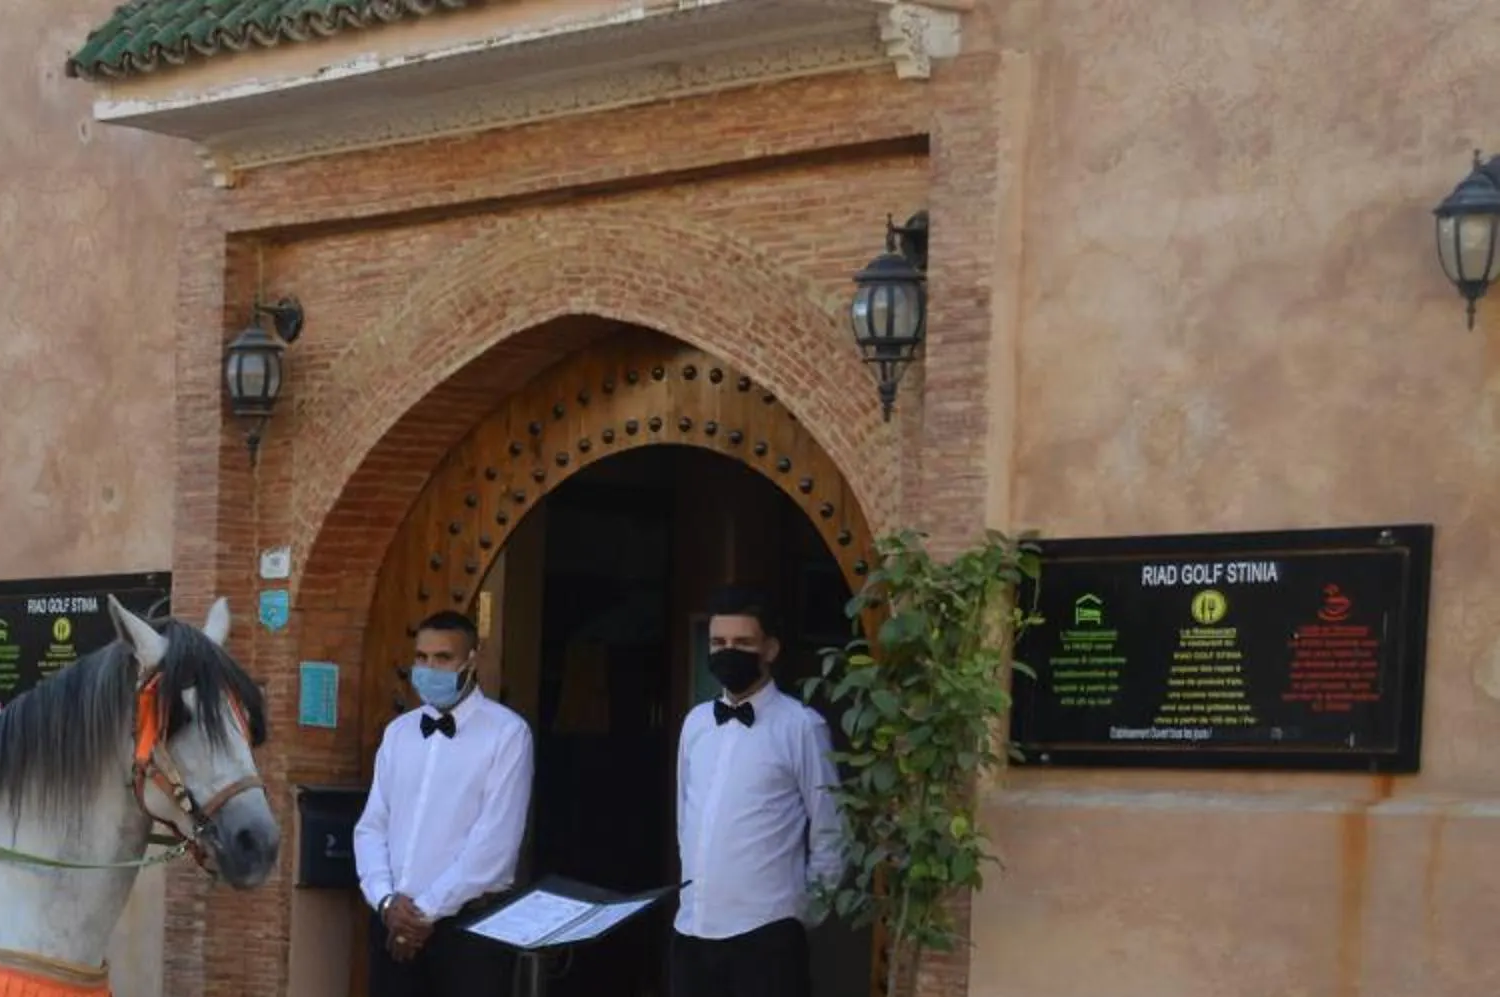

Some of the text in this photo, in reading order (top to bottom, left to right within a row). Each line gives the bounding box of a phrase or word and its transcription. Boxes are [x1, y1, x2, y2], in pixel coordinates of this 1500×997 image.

[1141, 561, 1278, 586] RIAD GOLF STINIA
